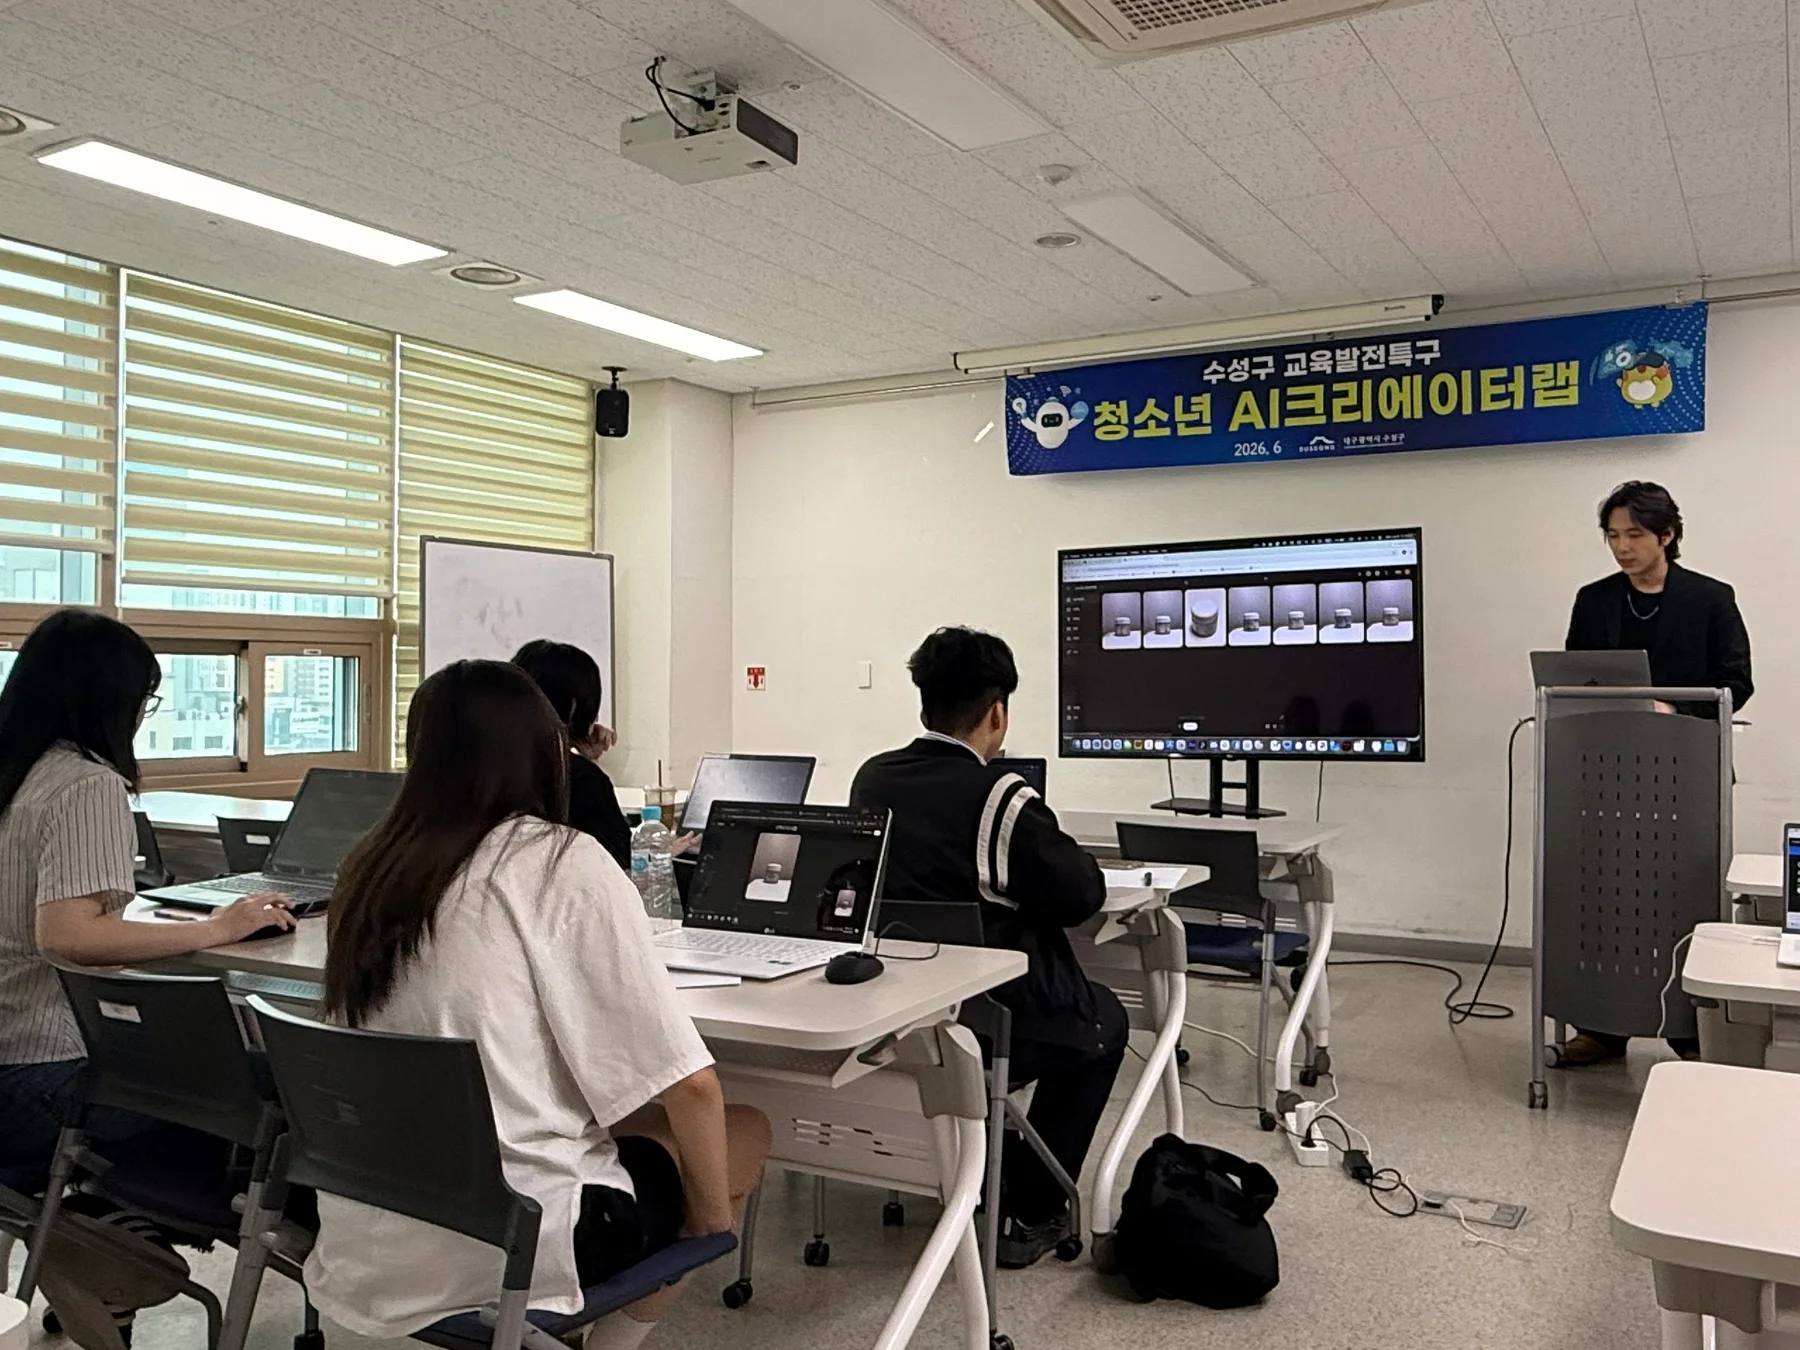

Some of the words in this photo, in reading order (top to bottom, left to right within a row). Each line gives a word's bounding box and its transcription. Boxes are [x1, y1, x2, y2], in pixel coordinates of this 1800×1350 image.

[1203, 355, 1276, 385] 수성구
[1283, 339, 1441, 378] 교육발전특구
[1093, 393, 1211, 441] 청소년
[1229, 361, 1580, 432] AI크리에이터랩
[1234, 441, 1270, 457] 2026.
[1273, 440, 1282, 454] 6
